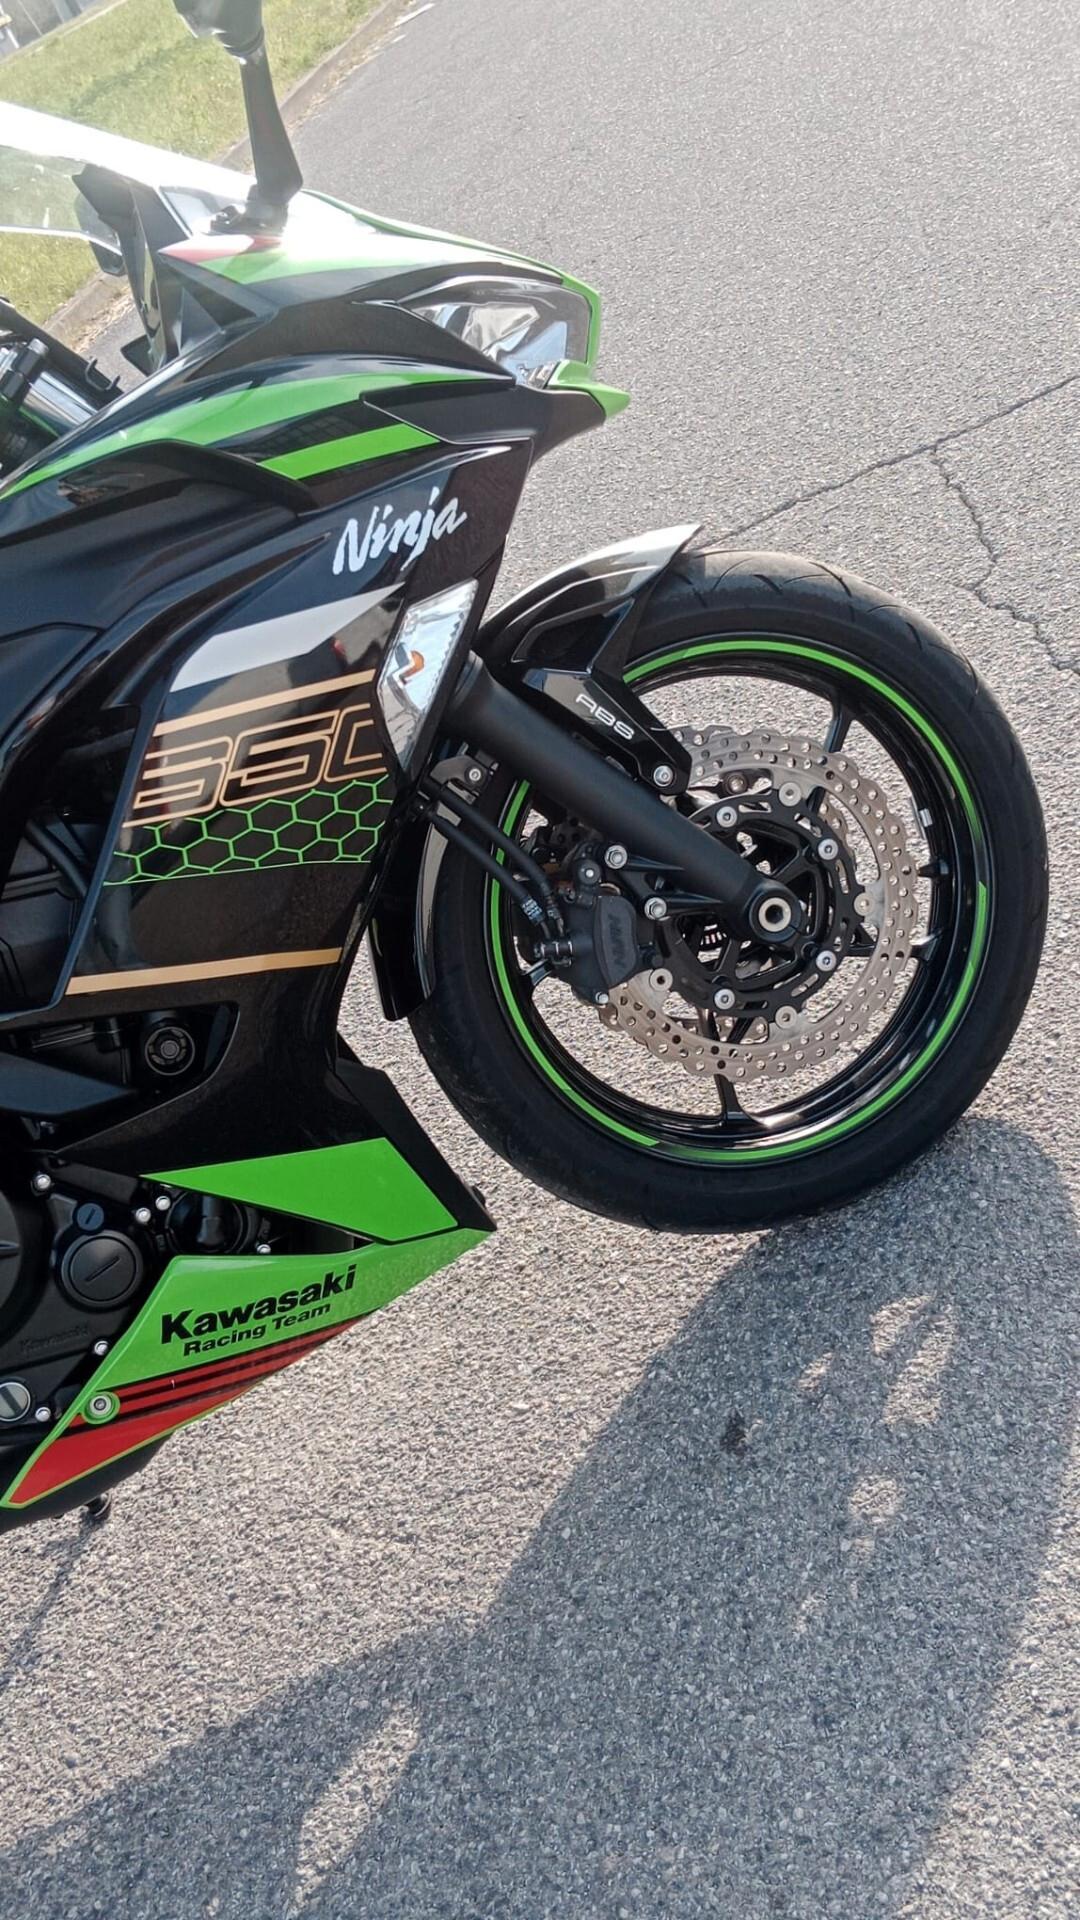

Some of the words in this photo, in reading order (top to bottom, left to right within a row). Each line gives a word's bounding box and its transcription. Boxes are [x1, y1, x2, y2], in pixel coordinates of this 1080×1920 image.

[333, 486, 467, 575] Ninja
[575, 693, 635, 740] ABS
[161, 1264, 357, 1344] Kawasaki
[183, 1324, 267, 1356] Racing
[272, 1303, 331, 1330] Team
